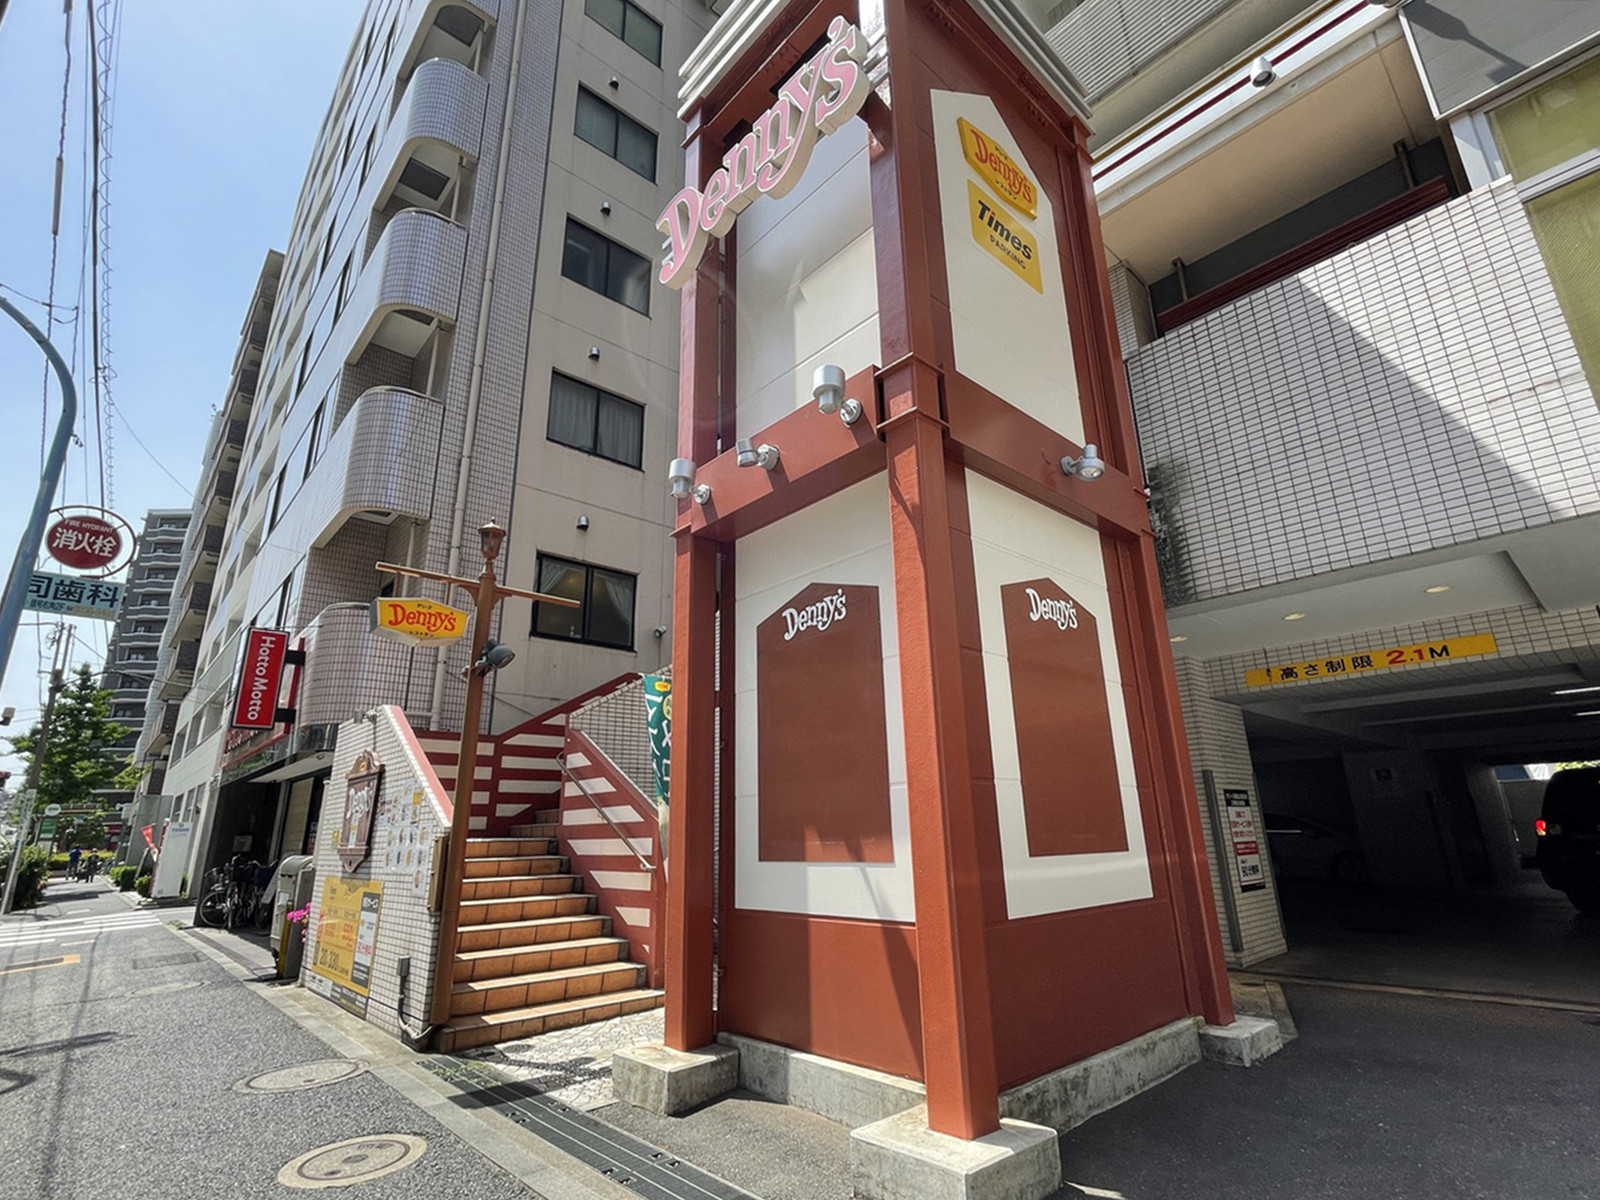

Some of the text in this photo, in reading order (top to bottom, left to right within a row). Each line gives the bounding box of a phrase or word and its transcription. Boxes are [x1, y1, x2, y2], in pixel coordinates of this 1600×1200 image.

[655, 15, 862, 288] Denny's
[970, 129, 1033, 205] Denny's
[978, 199, 1033, 261] Times
[989, 234, 1026, 270] PARKING
[52, 527, 117, 557] 消火栓
[64, 519, 80, 527] FIRE
[388, 603, 457, 633] Denny's
[782, 588, 847, 640] Denny's
[1027, 588, 1078, 630] Denny's
[247, 636, 276, 720] Hotto Motto
[1280, 644, 1450, 681] 高さ制限 2.1M
